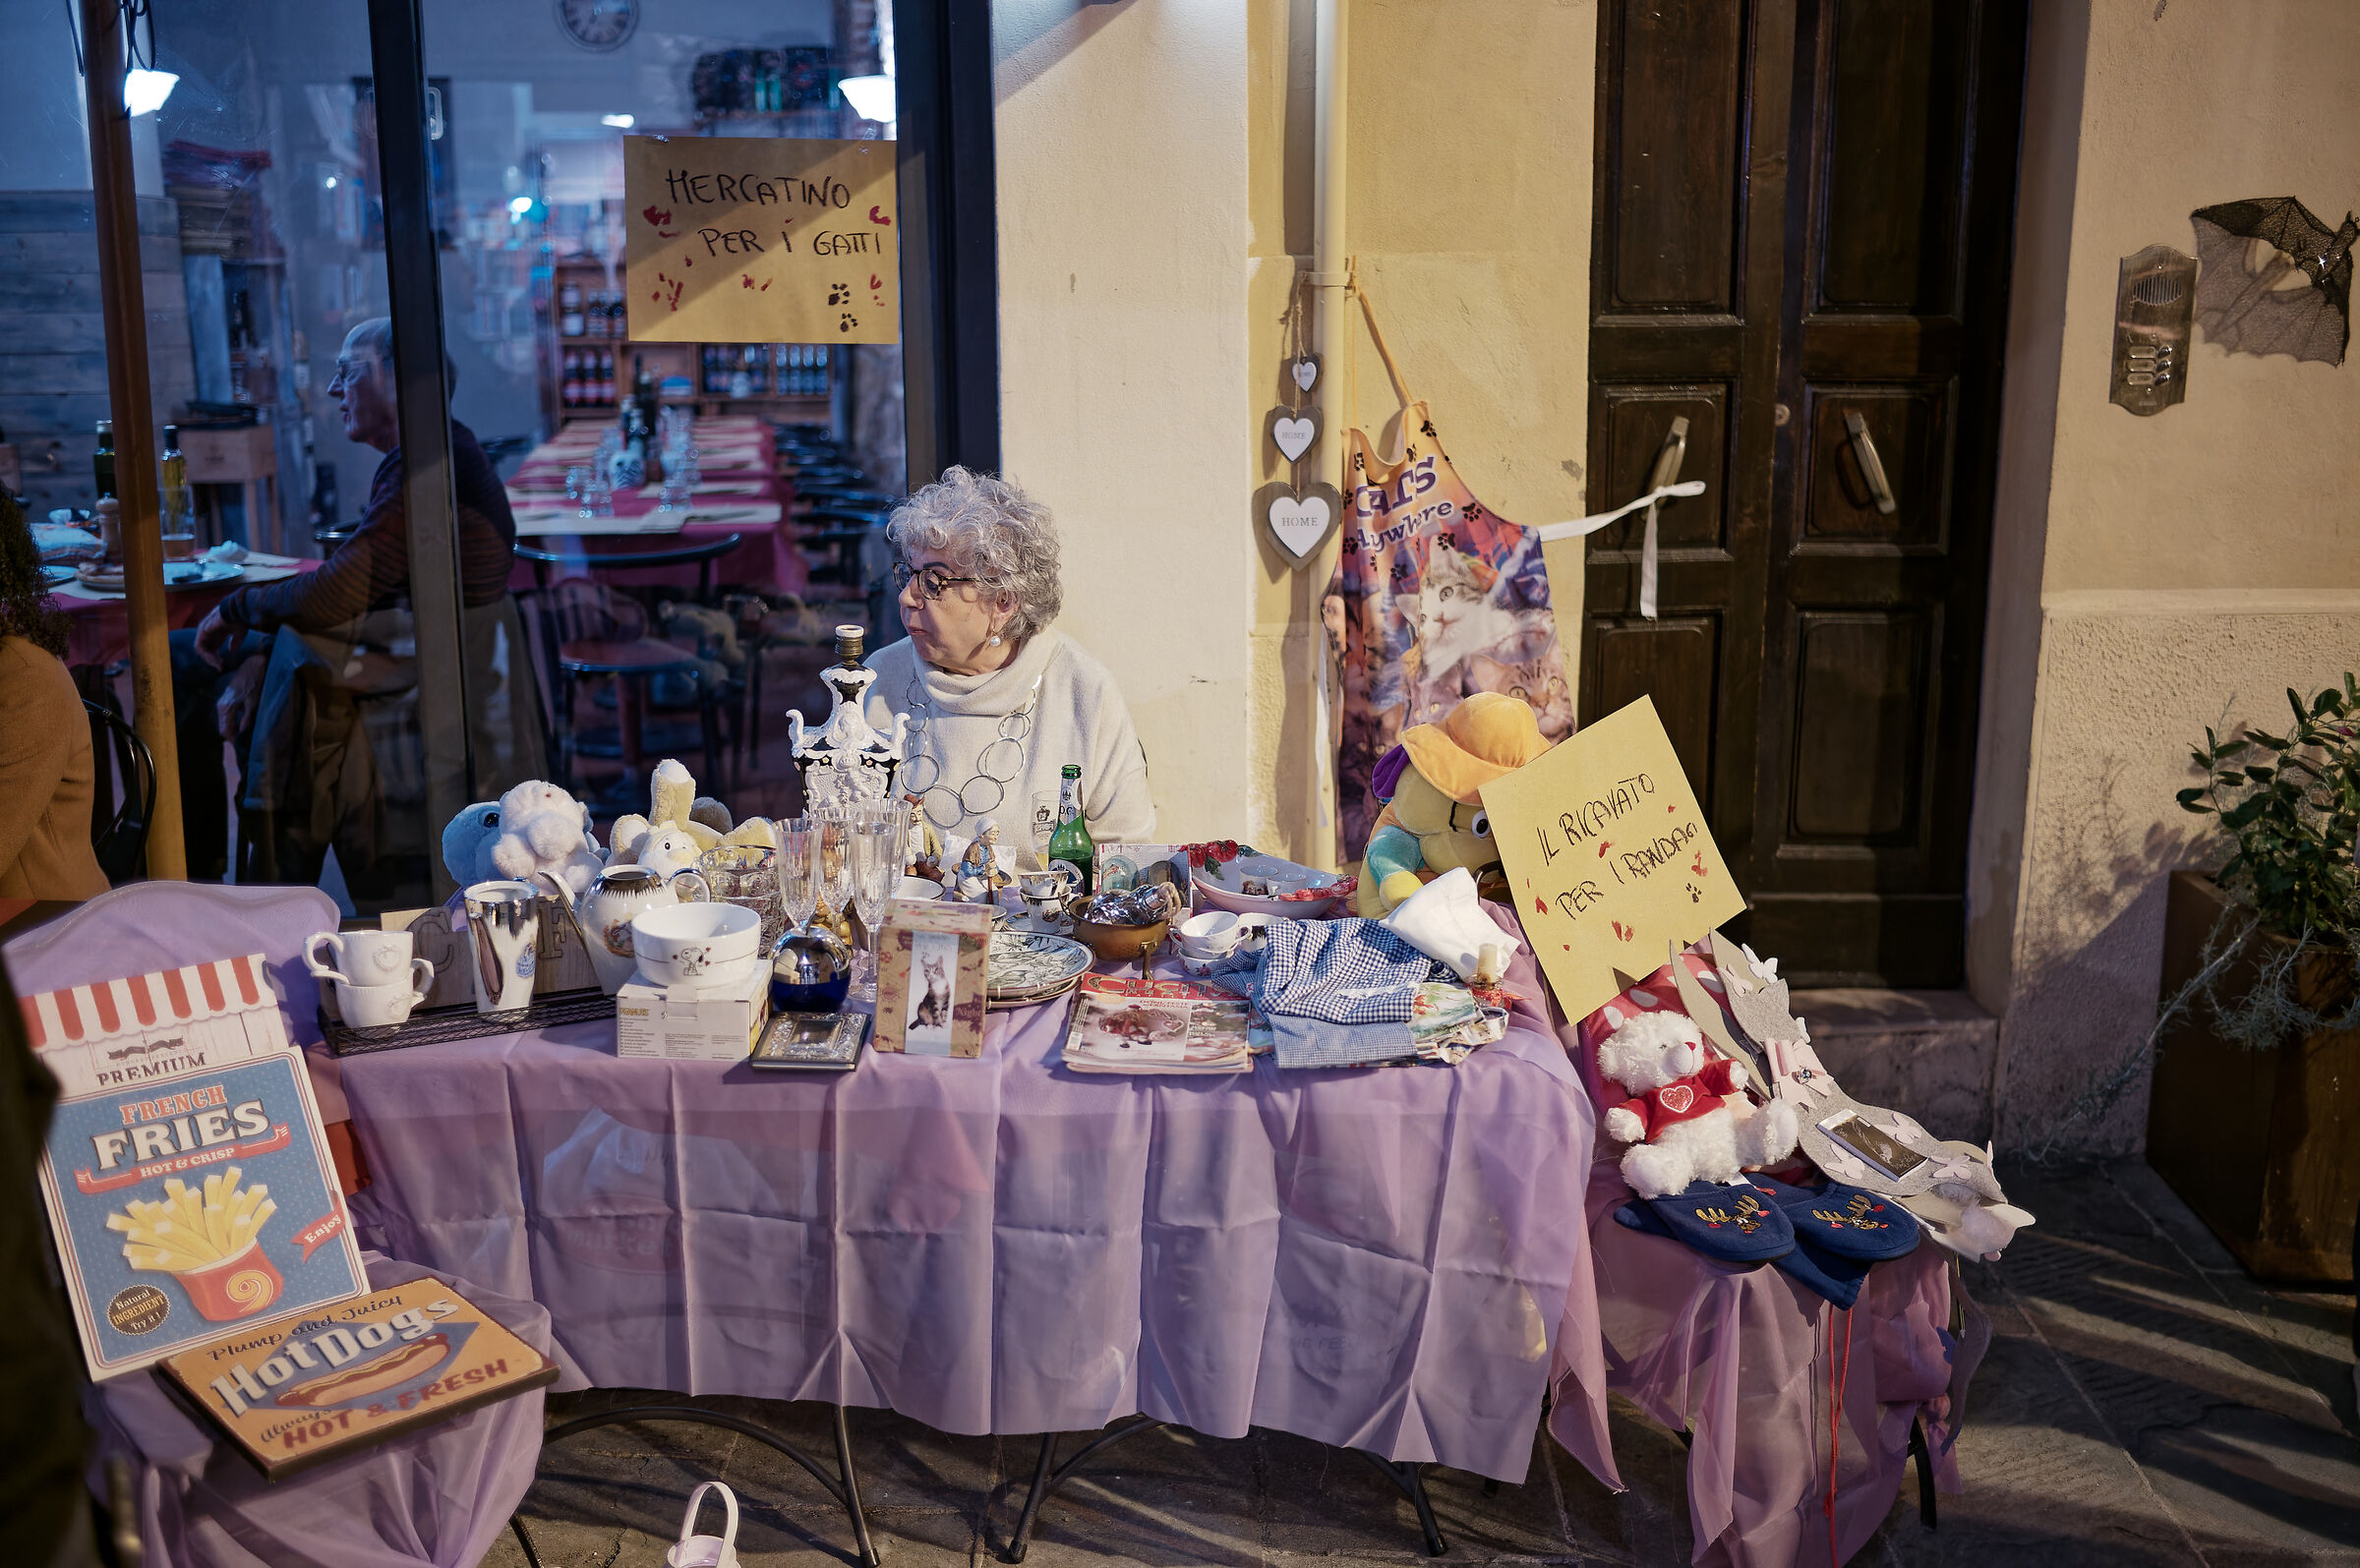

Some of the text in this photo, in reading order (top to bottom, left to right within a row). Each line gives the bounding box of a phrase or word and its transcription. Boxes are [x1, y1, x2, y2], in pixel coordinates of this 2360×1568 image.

[666, 168, 852, 208] MERCATINO
[697, 228, 881, 257] PER I GATTI
[1281, 432, 1308, 440] HOME
[1281, 517, 1319, 527] HOME
[1536, 773, 1655, 867] IL RICAVATO
[1555, 880, 1604, 920] PER
[1609, 860, 1625, 885] I
[96, 1052, 207, 1086] PREMIUM
[119, 1085, 228, 1125] FRENCH
[90, 1098, 270, 1171] FRIES
[140, 1147, 235, 1178] HOT & CRISP
[304, 1214, 342, 1244] Enjoy
[112, 1295, 164, 1325] INGREDIENT
[115, 1289, 150, 1309] Natural
[131, 1319, 148, 1330] Try
[206, 1296, 402, 1362] Plump and Juicy
[209, 1299, 460, 1419] Hot Dogs
[282, 1359, 509, 1449] HOT & FRESH
[261, 1409, 333, 1444] Always
